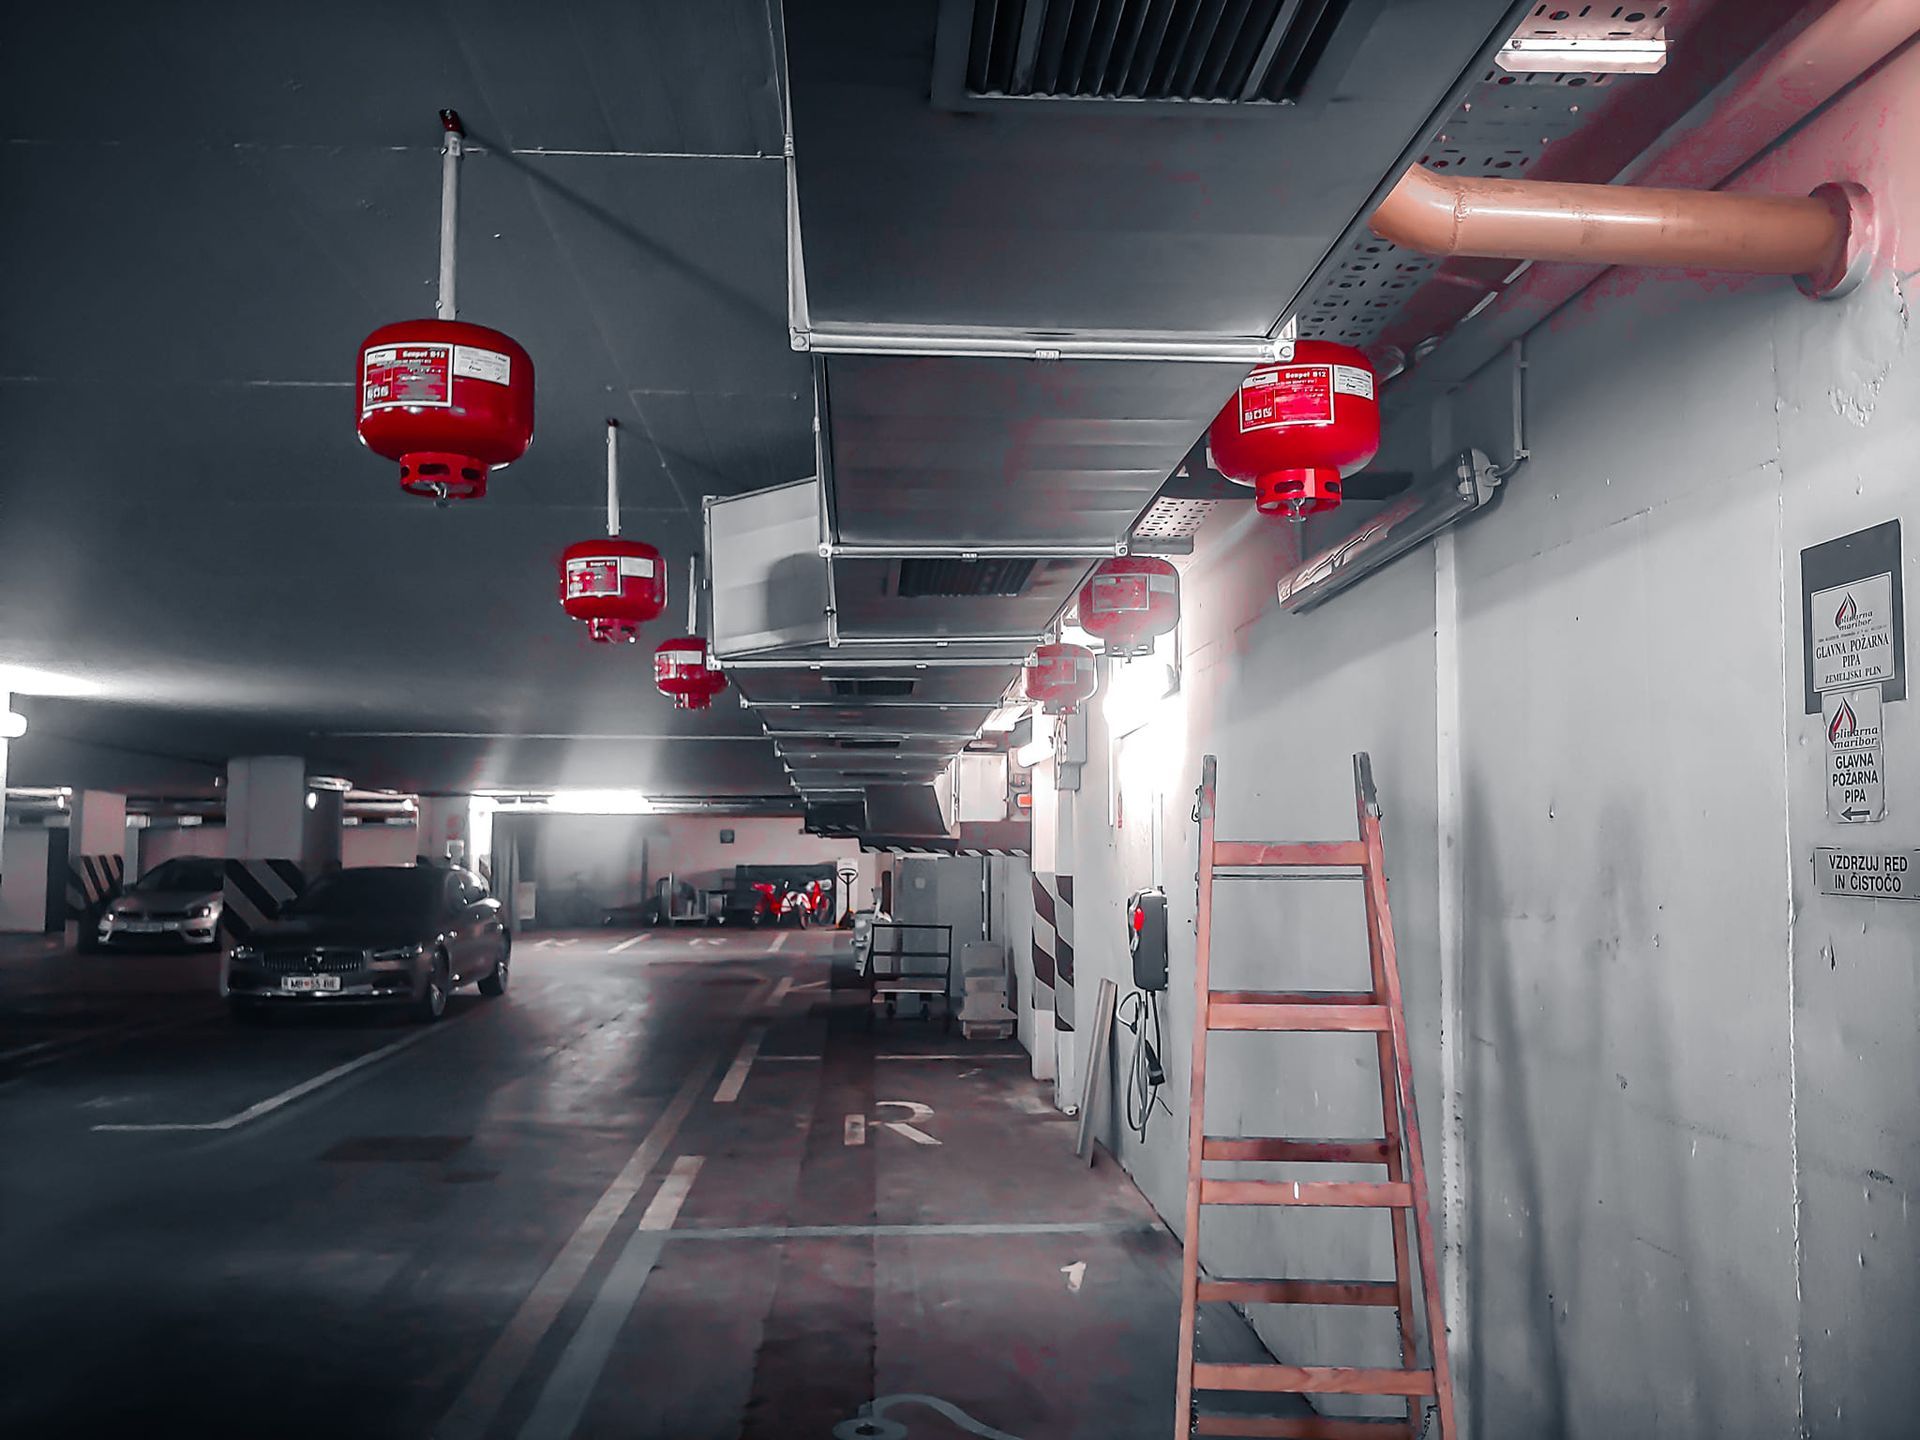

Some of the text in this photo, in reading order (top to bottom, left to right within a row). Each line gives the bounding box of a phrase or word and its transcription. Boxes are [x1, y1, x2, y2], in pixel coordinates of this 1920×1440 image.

[1816, 642, 1847, 660] GLAVNA
[1850, 632, 1890, 653] POŽARNA
[1842, 653, 1861, 669] PIPA
[1825, 665, 1882, 684] ZEMELJSKI PLIN
[1834, 736, 1877, 749] maribor
[1835, 752, 1874, 770] GLAVNA
[1832, 768, 1879, 787] POŽARNA
[1844, 788, 1867, 804] PIPA
[1828, 854, 1908, 872] VZDRZUJ RED
[1834, 872, 1902, 893] IN ČISTOČO
